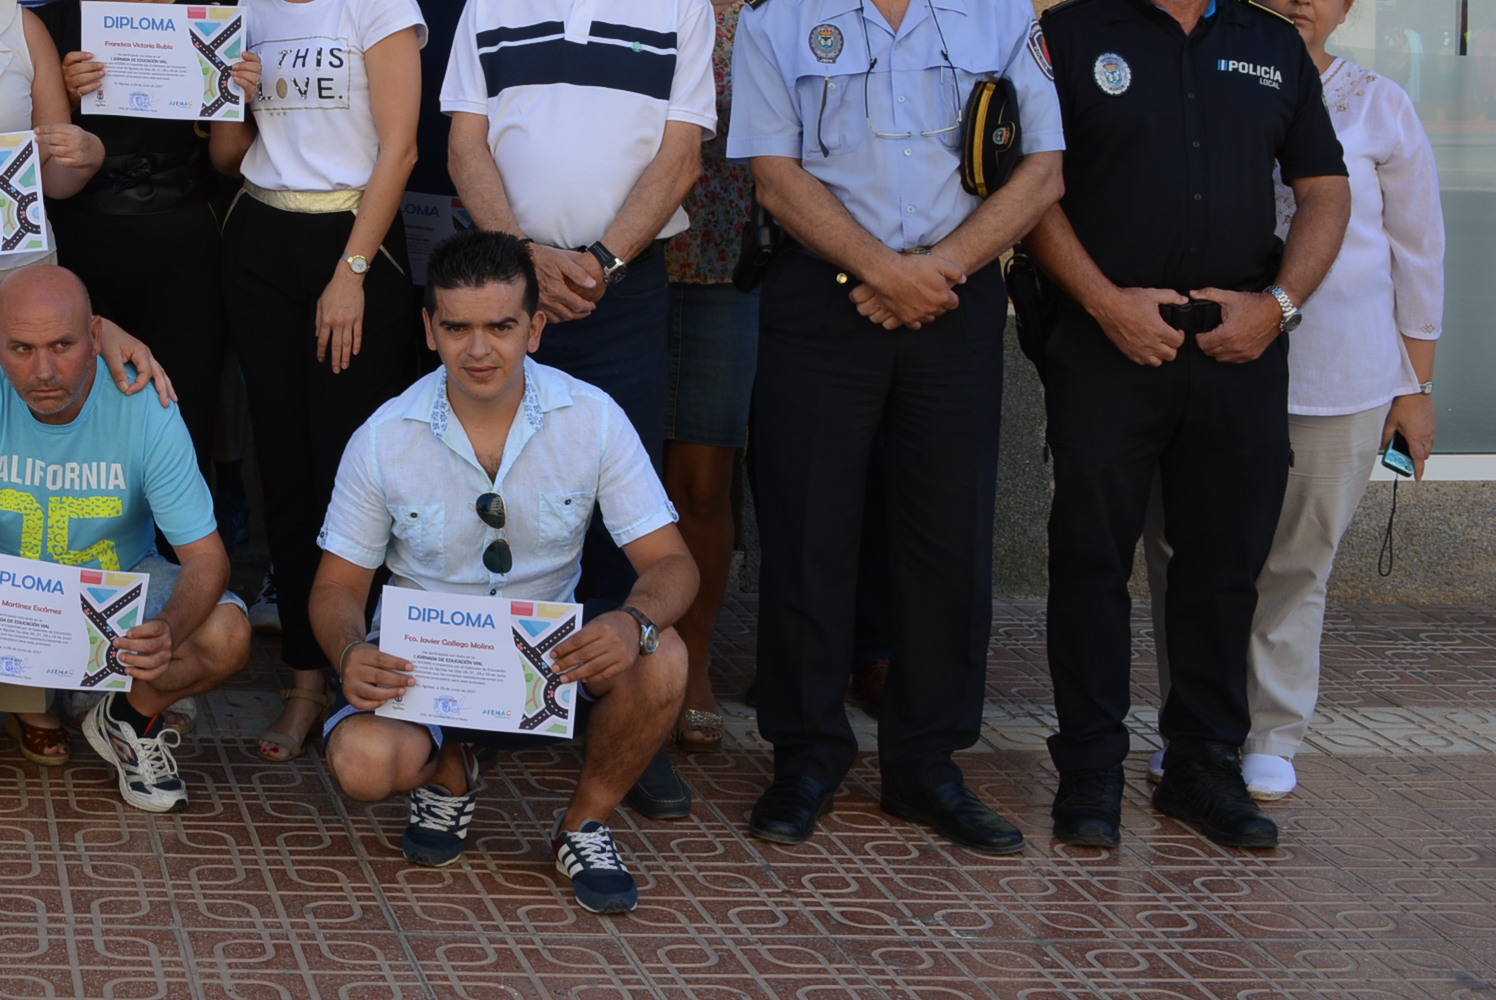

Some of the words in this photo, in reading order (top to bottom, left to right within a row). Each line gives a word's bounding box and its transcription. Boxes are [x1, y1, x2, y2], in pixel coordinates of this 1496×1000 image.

[104, 16, 176, 32] DIPLOMA
[277, 47, 344, 69] THIS
[1228, 60, 1282, 83] POLICÍA
[1260, 78, 1280, 89] LOCAL
[2, 599, 31, 610] Martínez
[33, 604, 62, 615] Escámez
[408, 606, 496, 629] DIPLOMA
[404, 634, 418, 642] Fco.
[420, 636, 440, 645] Javier
[442, 638, 469, 648] Gallego
[471, 642, 494, 650] Molina
